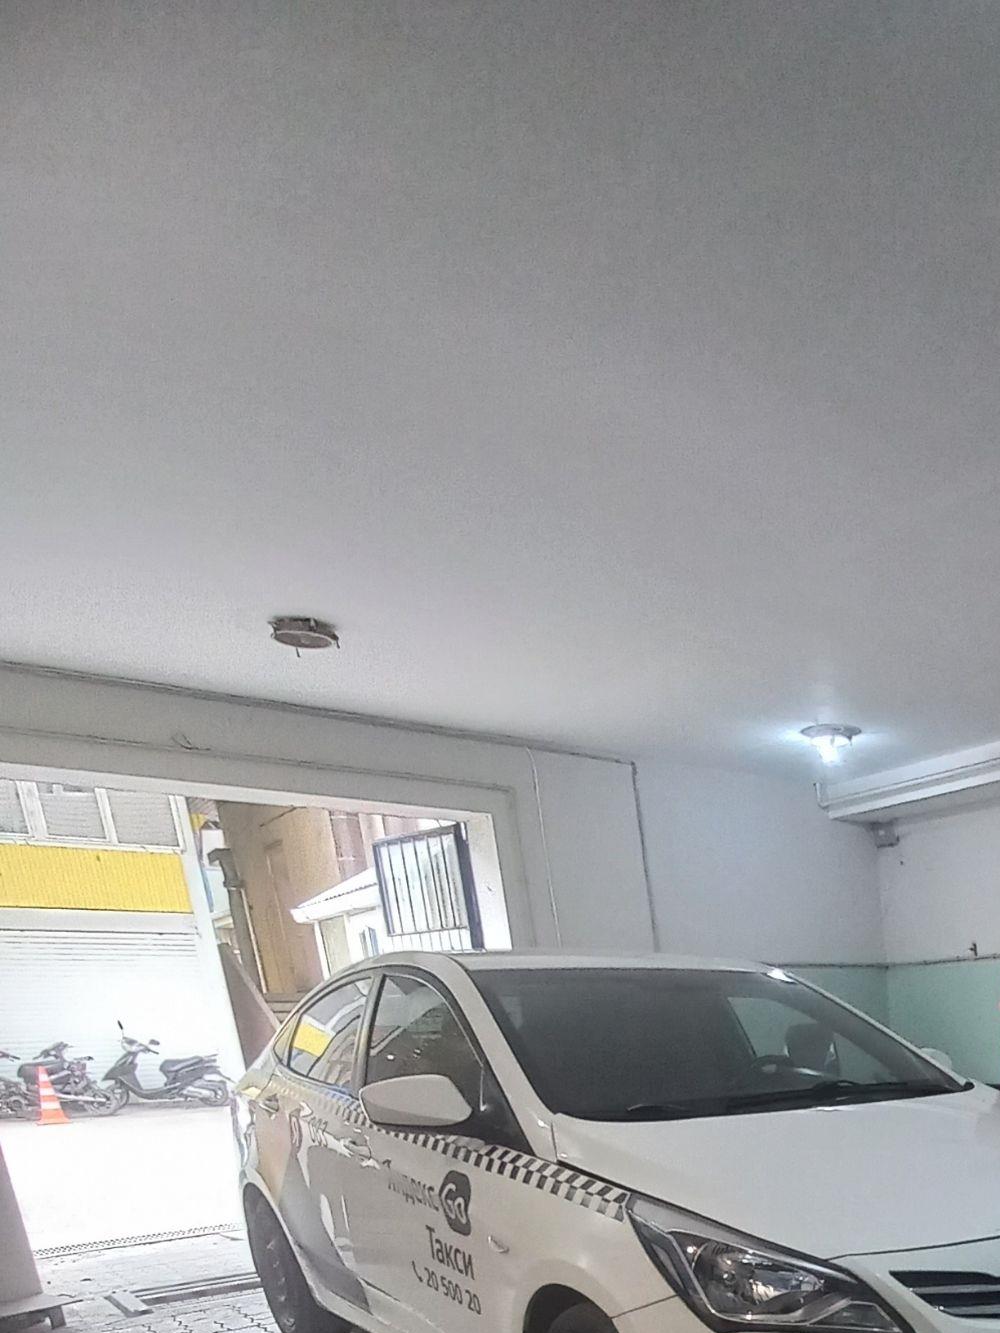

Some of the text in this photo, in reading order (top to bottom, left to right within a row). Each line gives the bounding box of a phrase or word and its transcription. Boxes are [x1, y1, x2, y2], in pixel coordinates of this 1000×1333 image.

[425, 1224, 475, 1281] Такси
[424, 1266, 482, 1316] 20 500 20
